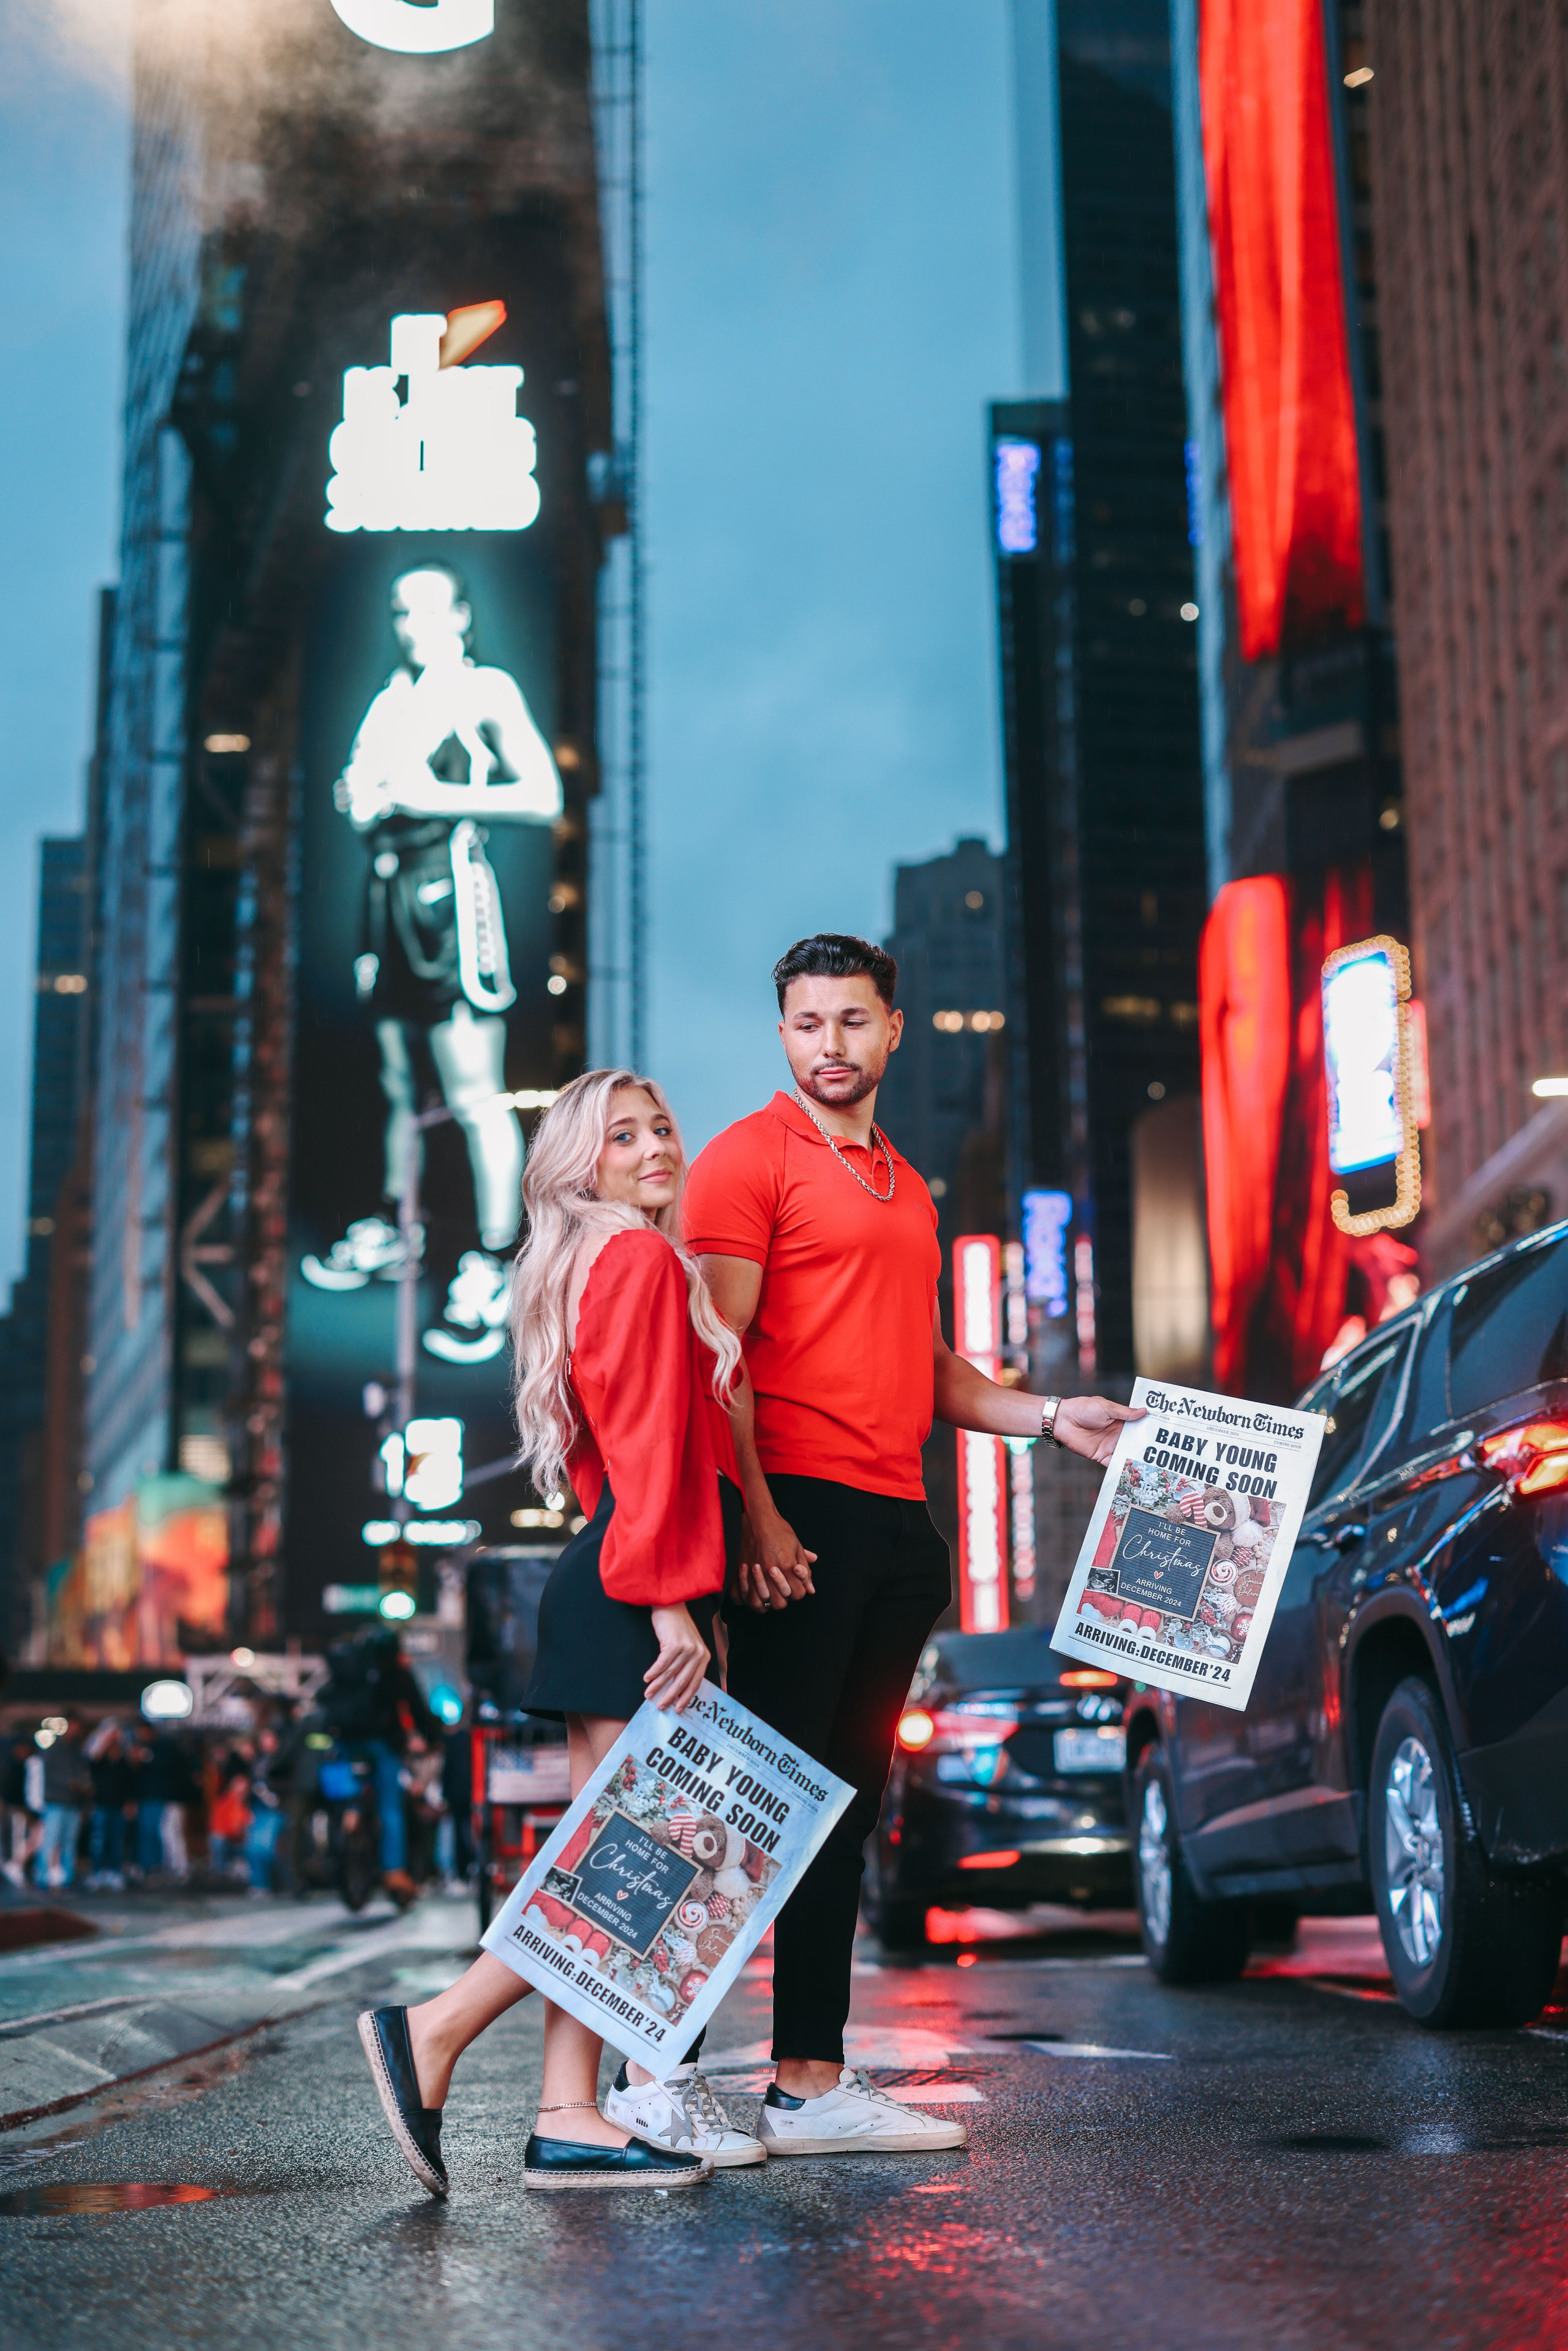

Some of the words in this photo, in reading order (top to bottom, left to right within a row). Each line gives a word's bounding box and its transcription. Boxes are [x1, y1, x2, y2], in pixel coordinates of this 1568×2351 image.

[1146, 1391, 1177, 1413] The
[1177, 1397, 1251, 1429] Newborn
[1253, 1413, 1305, 1440] Times
[1155, 1427, 1208, 1456] BABY
[1215, 1442, 1278, 1473] YOUNG
[1143, 1446, 1220, 1485] COMING
[1226, 1471, 1278, 1499] SOON
[1148, 1527, 1172, 1541] HOME
[1174, 1536, 1191, 1547] FOR
[1159, 1521, 1172, 1531] I'LL
[1175, 1526, 1186, 1536] BE
[1123, 1534, 1204, 1577] Christmas
[1120, 1582, 1163, 1601] DECEMBER
[1164, 1597, 1182, 1607] 2024
[1135, 1578, 1172, 1594] ARRIVING
[1242, 1574, 1263, 1587] Specia
[703, 1700, 778, 1766] Newborn
[777, 1753, 829, 1802] Times
[666, 1726, 724, 1774] BABY
[724, 1764, 790, 1825] YOUNG
[645, 1746, 725, 1813] COMING
[725, 1803, 782, 1854] SOON
[791, 1791, 807, 1804] COMING
[625, 1839, 651, 1861] HOME
[650, 1857, 669, 1874] FOR
[639, 1836, 653, 1851] I'LL
[655, 1847, 668, 1860] BE
[590, 1843, 674, 1909] Christmas
[577, 1892, 619, 1926] DECEMBER
[619, 1923, 638, 1939] 2024
[594, 1892, 632, 1922] ARRIVING
